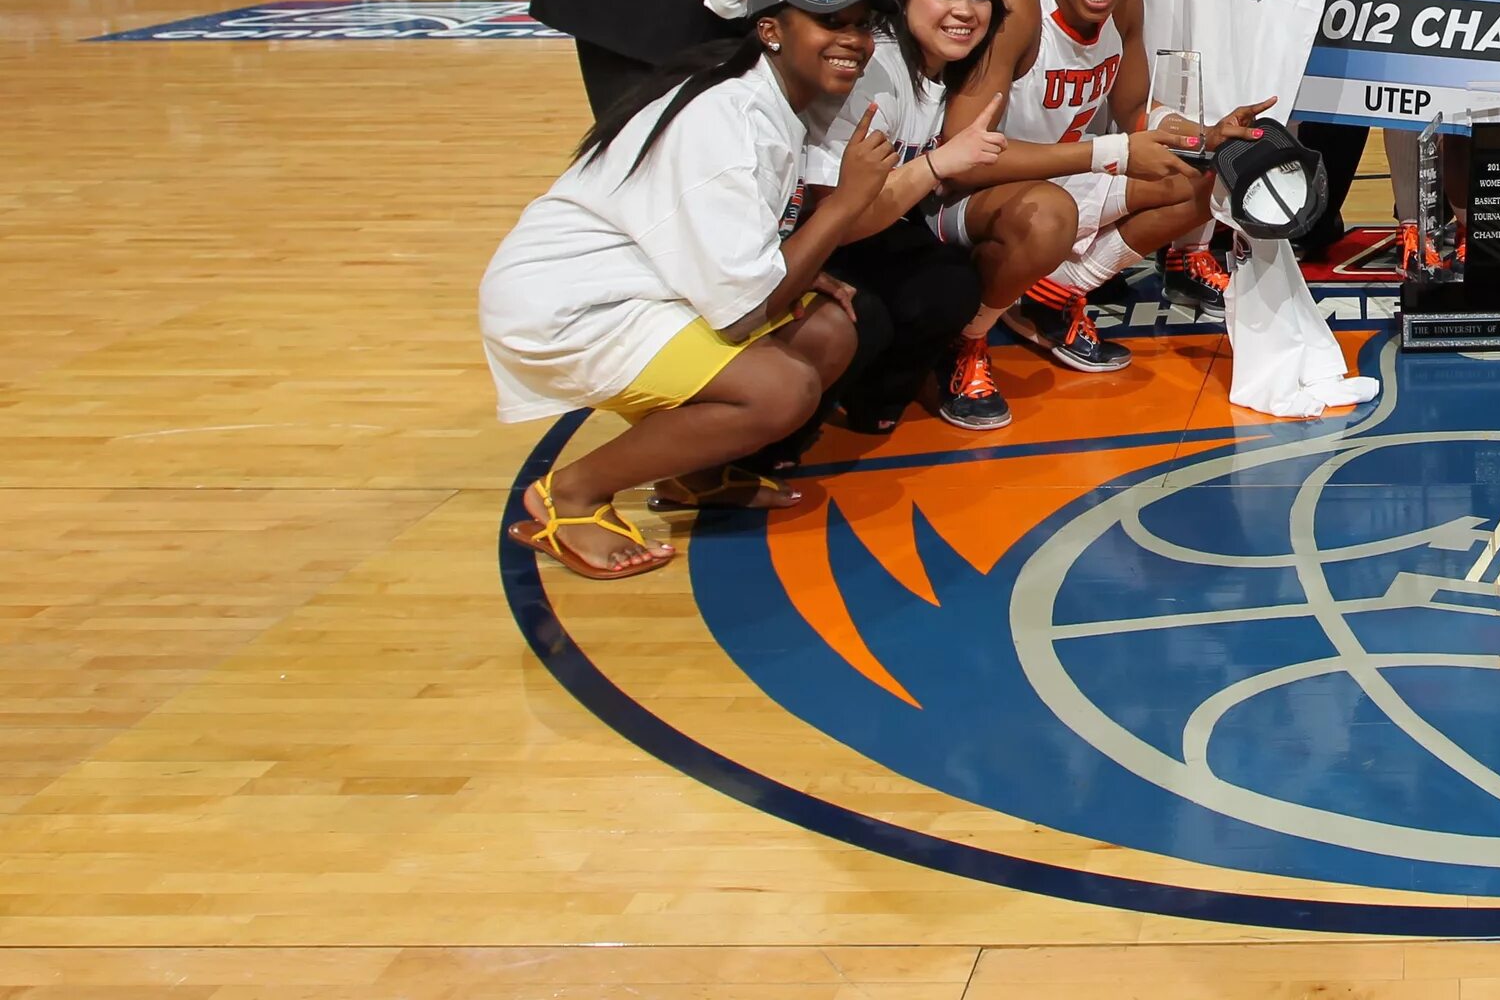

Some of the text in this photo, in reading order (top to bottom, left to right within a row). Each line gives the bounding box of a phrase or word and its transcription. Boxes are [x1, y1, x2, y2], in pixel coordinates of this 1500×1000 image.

[1322, 0, 1401, 44] 012
[1043, 53, 1120, 110] UTEP
[1365, 85, 1431, 115] UTEP
[1414, 326, 1429, 335] THE
[1434, 325, 1482, 334] UNIVERSITY
[1487, 325, 1497, 333] OF
